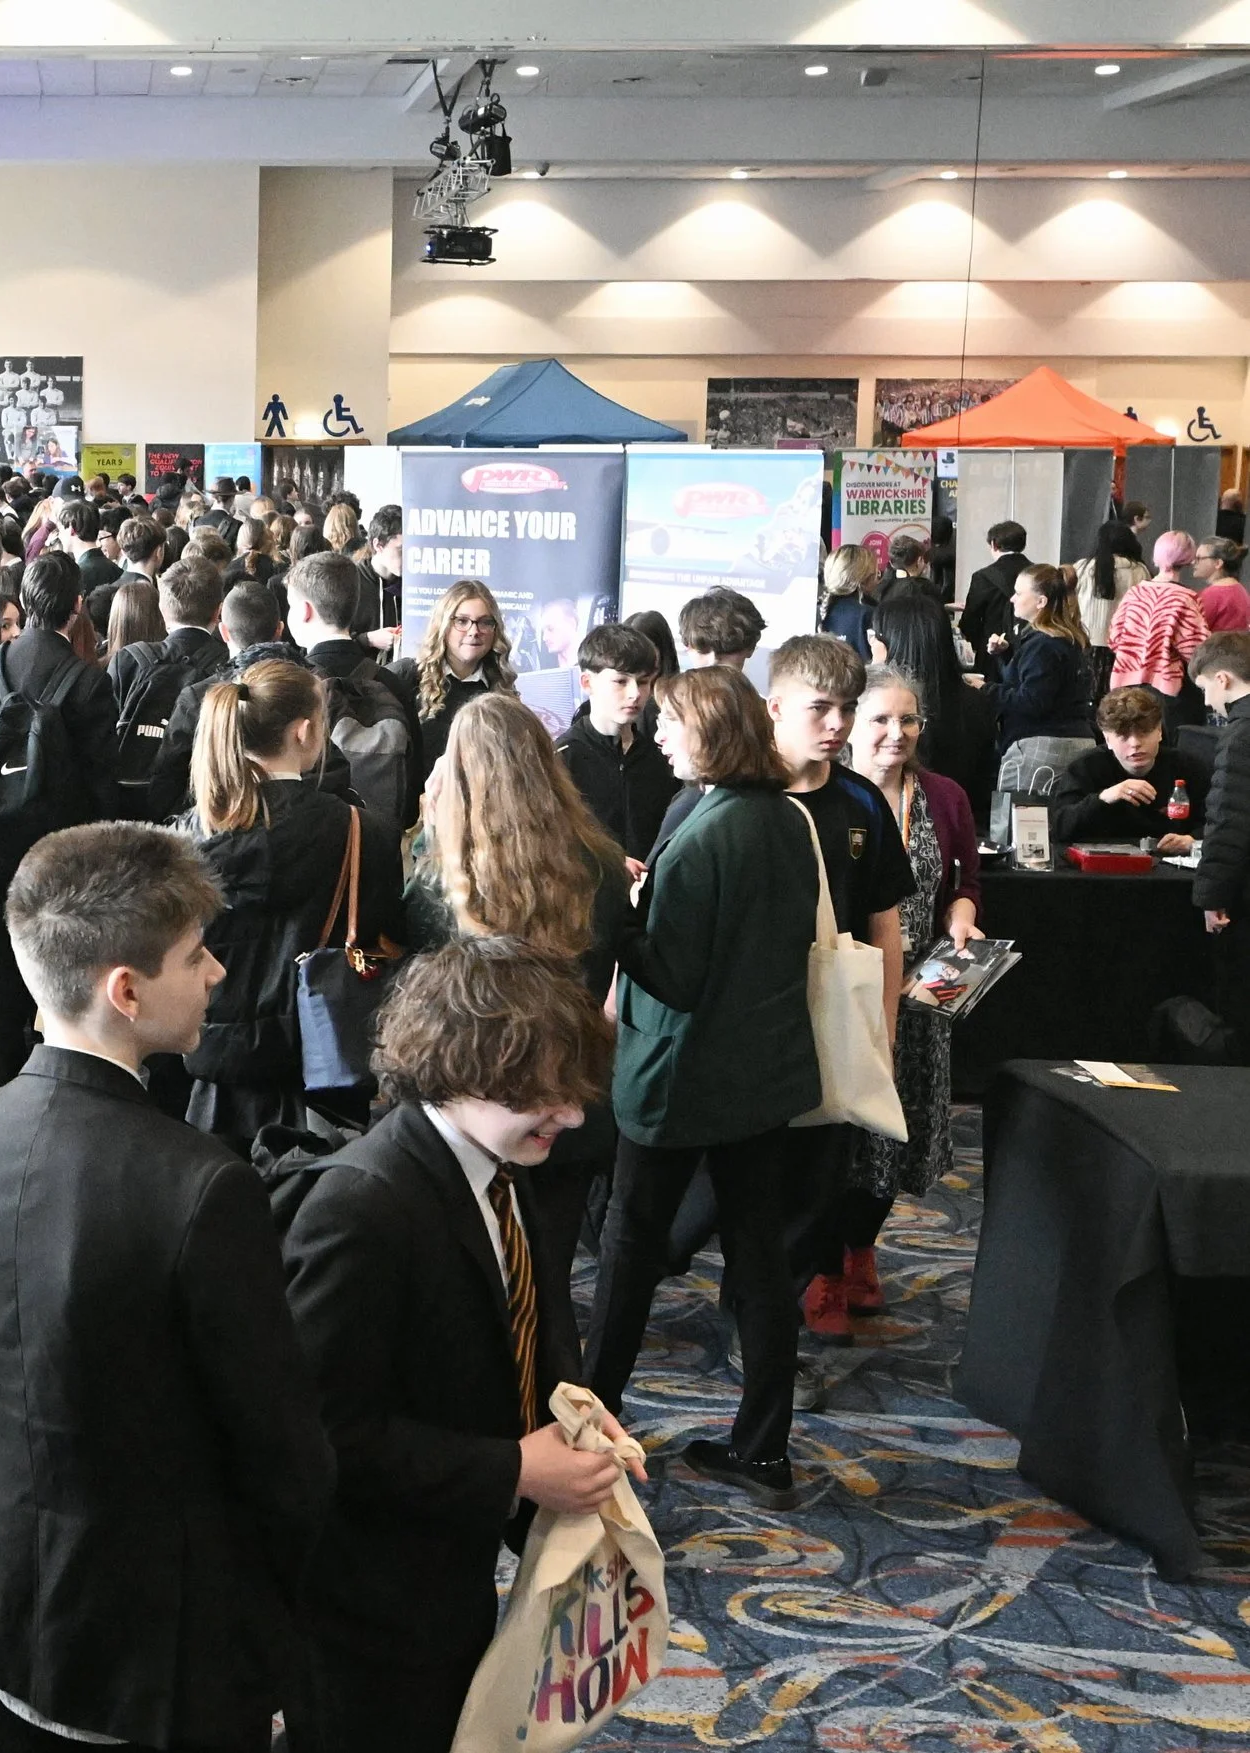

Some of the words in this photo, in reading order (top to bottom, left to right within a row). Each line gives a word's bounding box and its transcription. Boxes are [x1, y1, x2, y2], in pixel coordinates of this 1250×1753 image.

[470, 469, 543, 493] PWR
[846, 489, 926, 499] WARWICKSHIRE
[846, 500, 926, 516] LIBRARIES
[406, 508, 510, 539] ADVANCE
[514, 511, 577, 541] YOUR
[406, 546, 491, 577] CAREER
[137, 724, 165, 739] PUM
[530, 1628, 649, 1724] HOW
